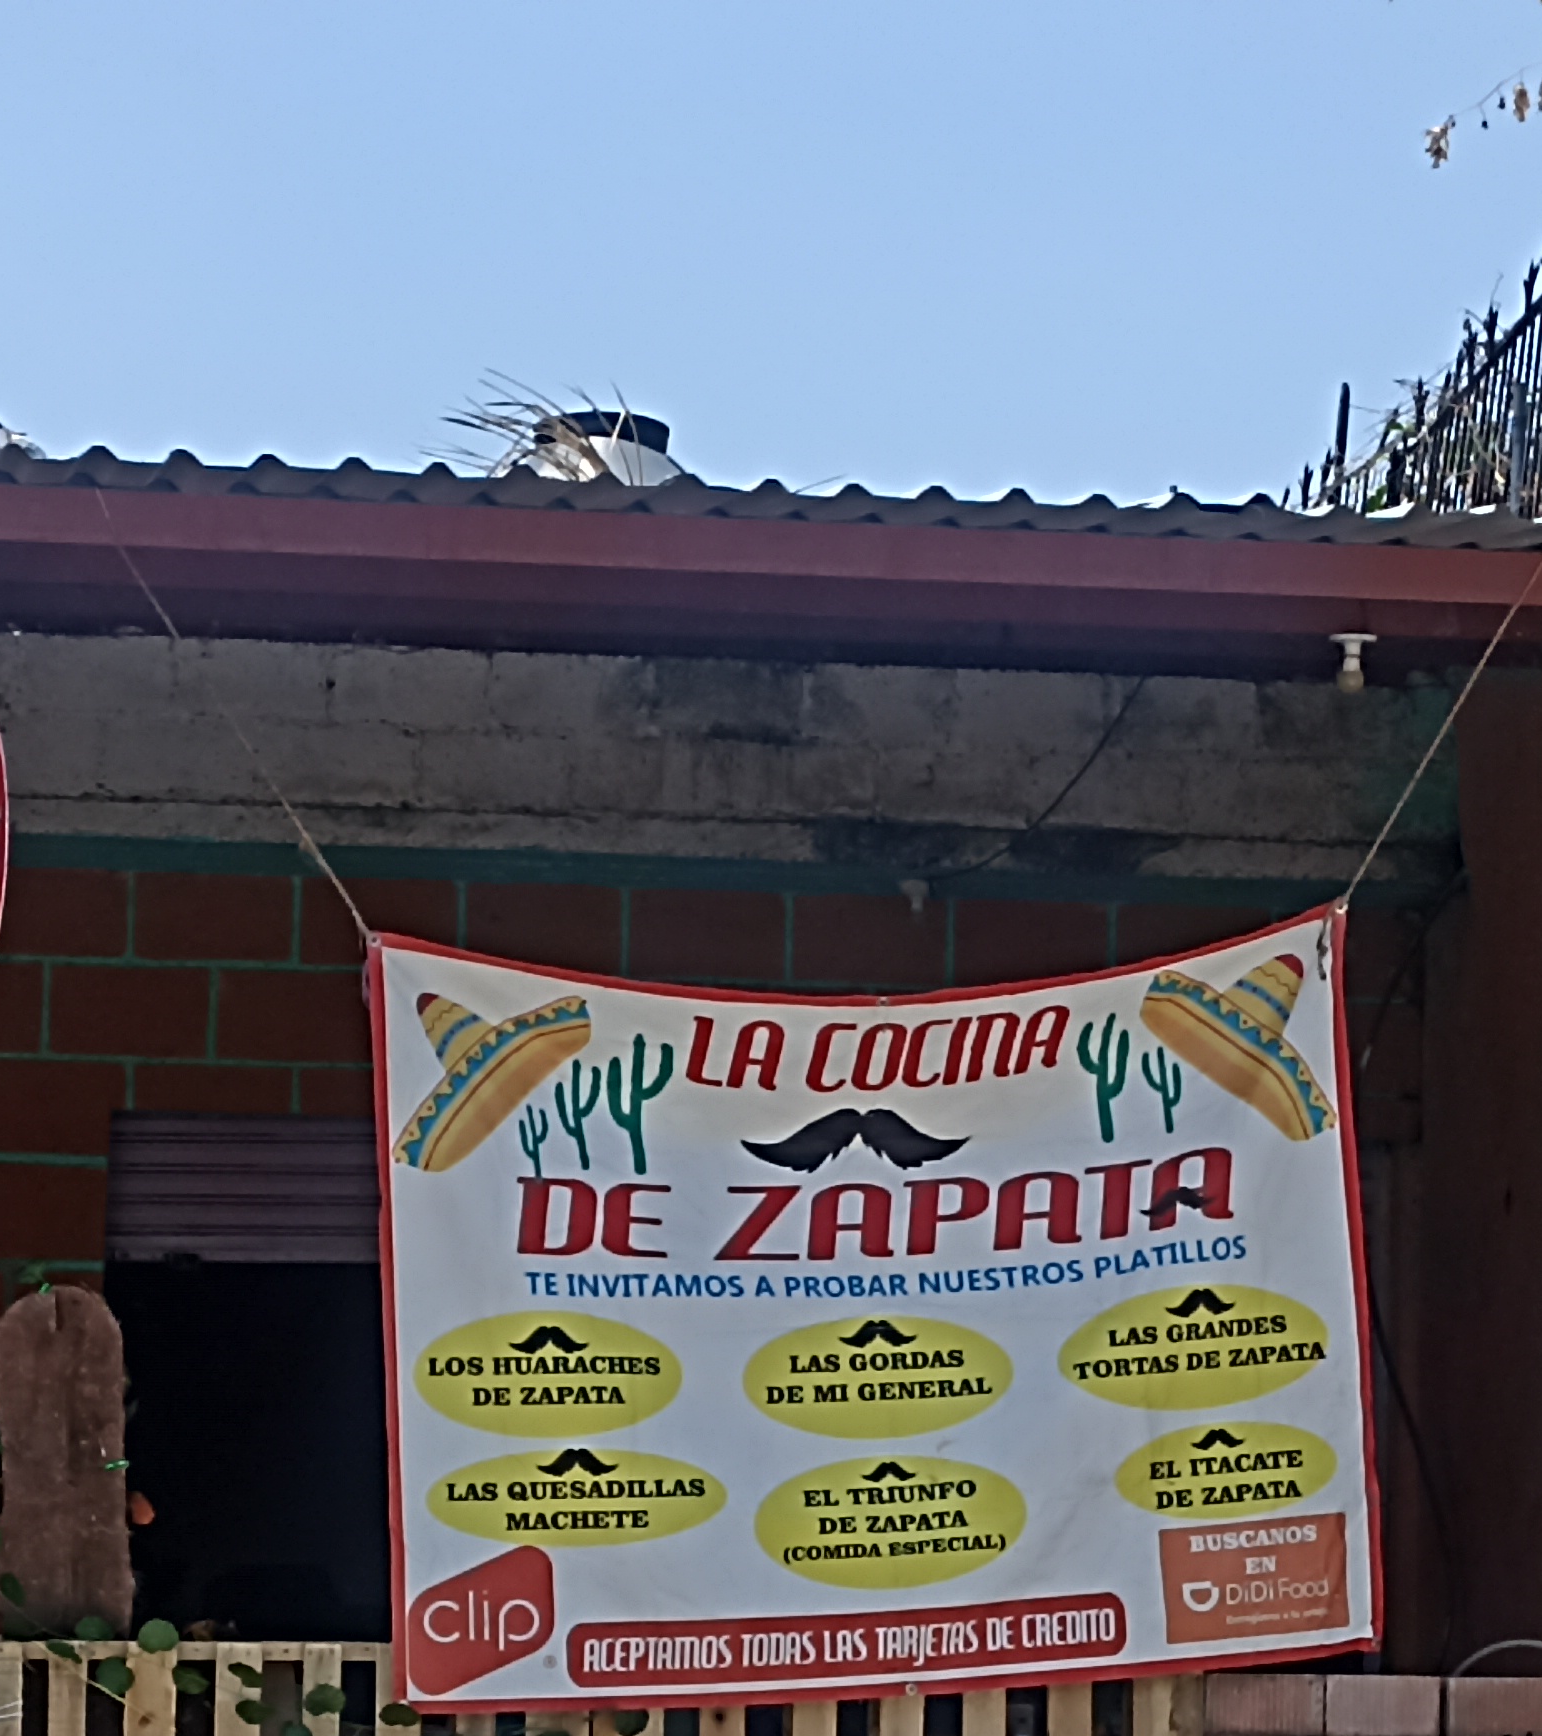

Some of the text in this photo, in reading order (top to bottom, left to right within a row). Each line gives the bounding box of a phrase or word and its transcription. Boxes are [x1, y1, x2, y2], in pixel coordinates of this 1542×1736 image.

[685, 1005, 1071, 1093] LA COCINA
[516, 1147, 1235, 1262] DE ZAPATA
[525, 1235, 1247, 1299] TE INVITAMOS A PROBAR NUESTROS PLATILLOS
[1108, 1314, 1287, 1347] LAS GRANDES
[428, 1356, 661, 1376] LOS HUARACHES
[789, 1349, 965, 1374] LAS GORDAS
[1073, 1342, 1327, 1380] TORTAS DE ZAPATA
[472, 1386, 626, 1406] DE ZAPATA
[766, 1377, 993, 1405] DE MI GENERAL
[1149, 1450, 1304, 1480] EL ITACATE
[446, 1479, 706, 1502] LAS QUESADILLAS
[803, 1480, 977, 1507] EL TRIUNFO
[1156, 1479, 1303, 1510] DE ZAPATA
[505, 1509, 649, 1531] MACHETE
[818, 1510, 969, 1535] DE ZAPATA
[783, 1533, 1007, 1565] (COMIDA ESPECIAL)
[1189, 1524, 1317, 1553] BUSCANOS
[1245, 1555, 1277, 1575] EN
[1225, 1577, 1329, 1605] DiDi Food
[422, 1590, 541, 1651] clip
[582, 1608, 1116, 1673] ACEPTAMOS TODAS LAS TARJETAS DE CREDITO
